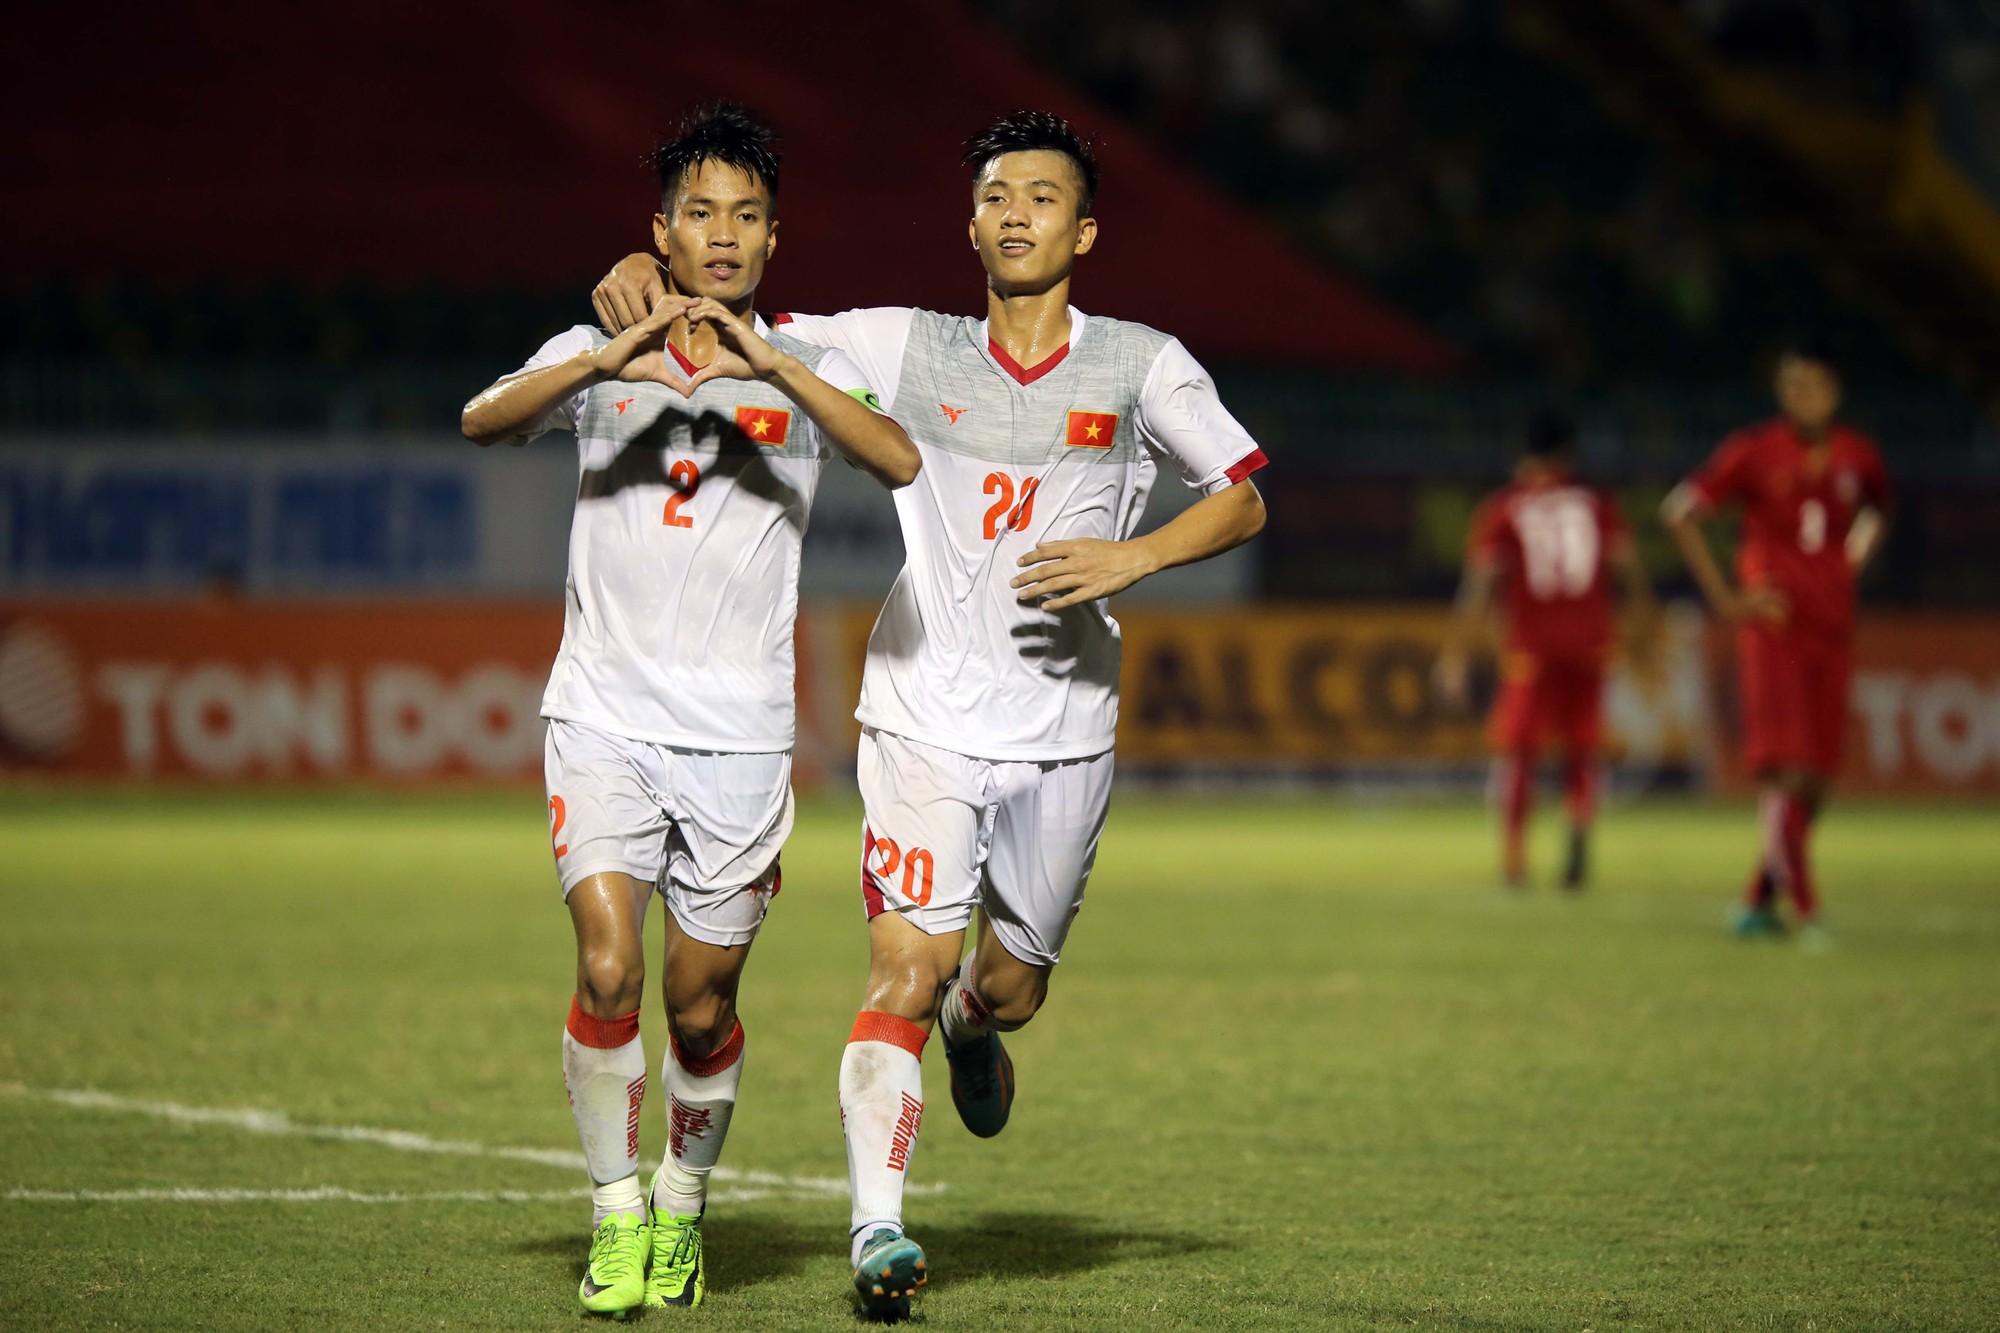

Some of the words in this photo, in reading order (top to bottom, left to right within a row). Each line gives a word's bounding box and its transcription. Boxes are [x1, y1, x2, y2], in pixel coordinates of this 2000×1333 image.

[663, 459, 700, 528] 2
[982, 471, 1040, 540] 20
[364, 661, 546, 774] DO
[1852, 671, 2000, 780] TO
[548, 794, 568, 863] 2
[874, 837, 934, 908] 20
